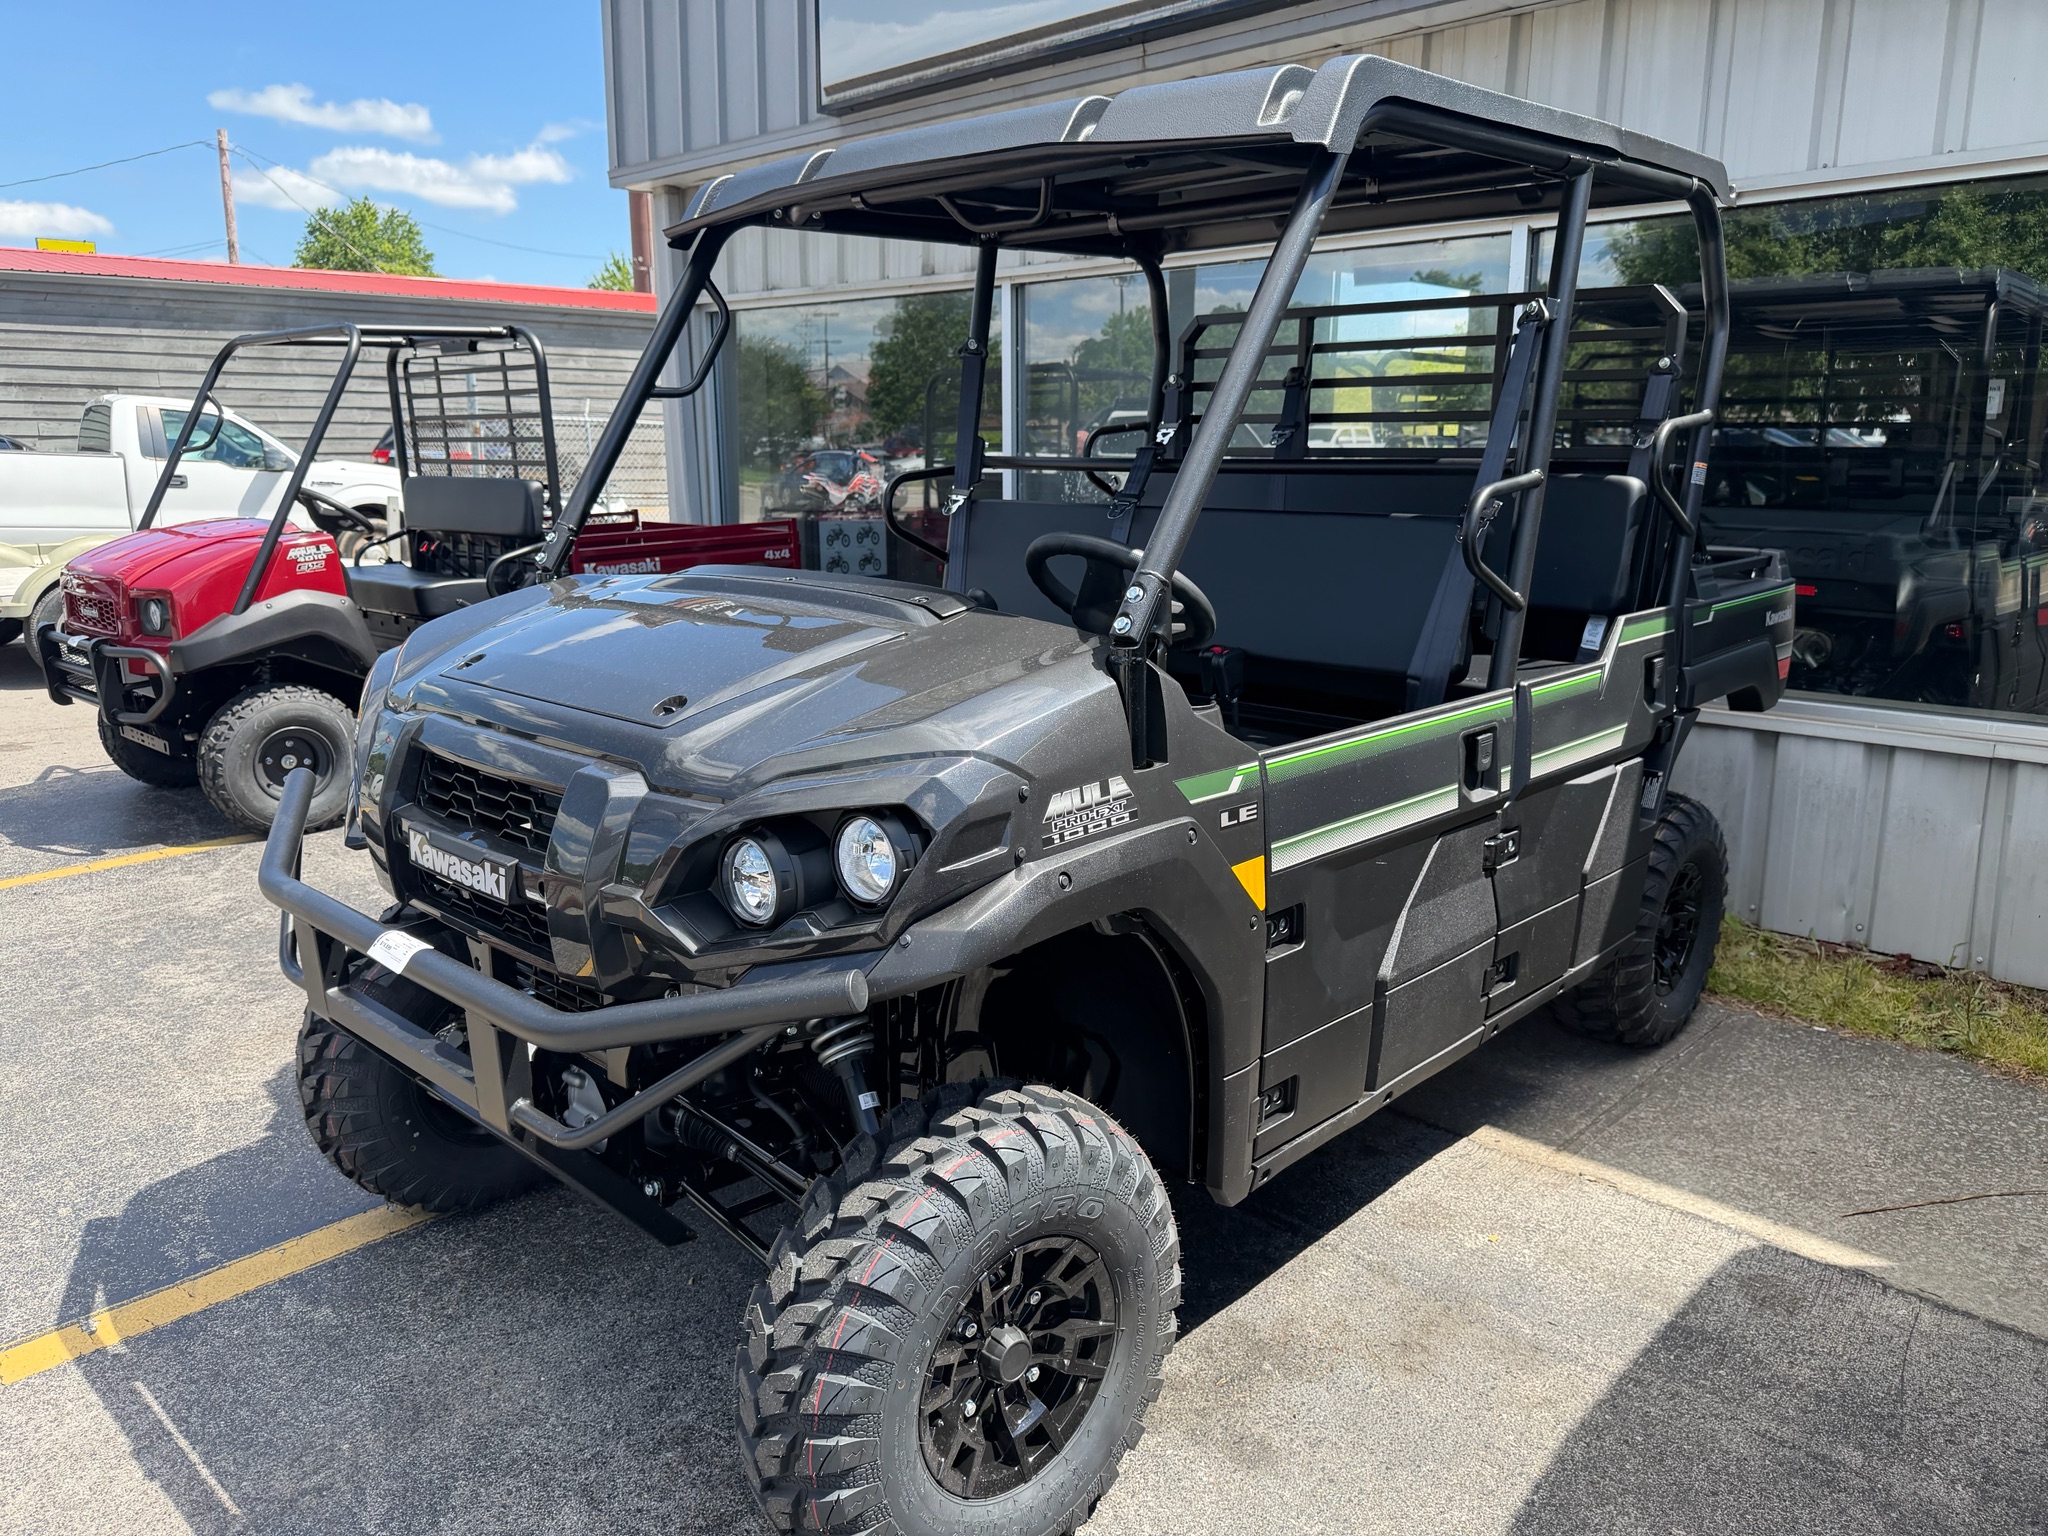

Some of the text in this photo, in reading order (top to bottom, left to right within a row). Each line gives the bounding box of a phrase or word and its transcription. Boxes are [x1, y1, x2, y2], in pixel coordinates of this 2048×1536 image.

[583, 556, 661, 575] Kawasaki
[764, 548, 790, 560] 4x4
[1765, 605, 1793, 627] Kawasaki
[1043, 775, 1135, 824] MULE
[1050, 811, 1132, 845] 1000
[1051, 800, 1128, 832] PRO-FXT
[1220, 803, 1258, 828] LE
[409, 828, 506, 901] Kawasaki
